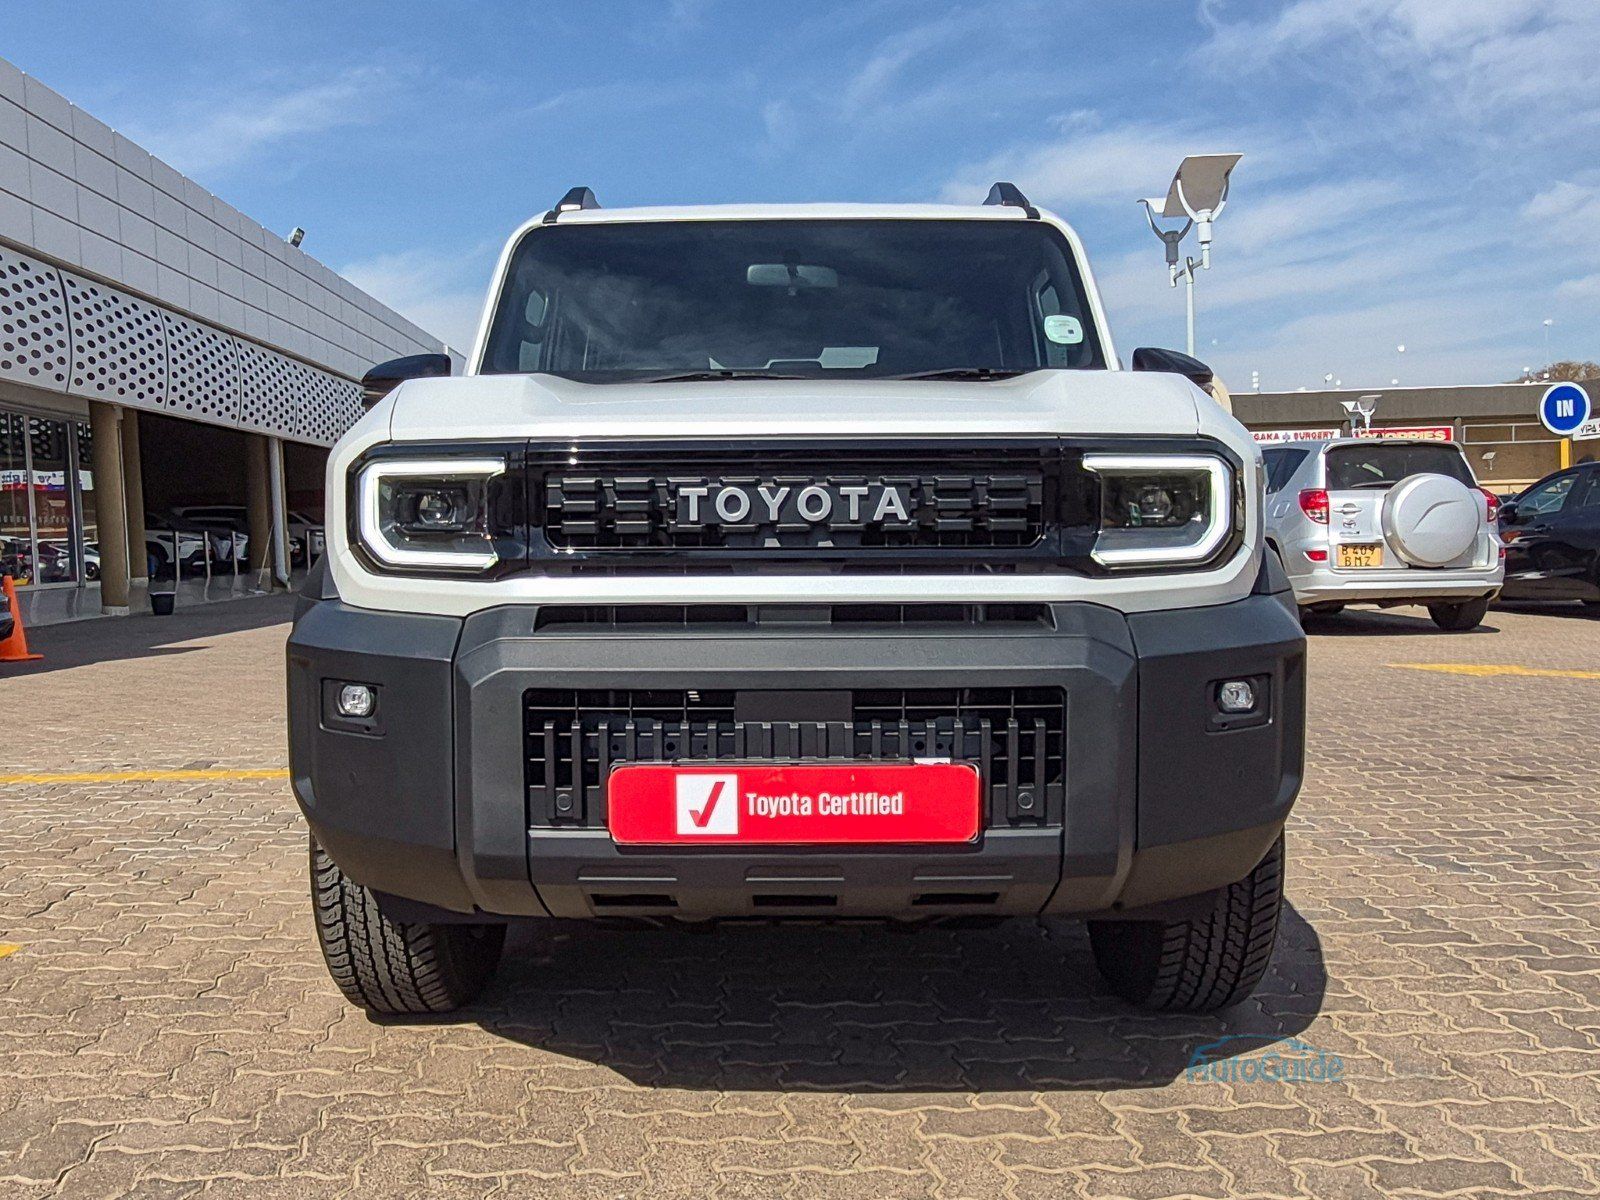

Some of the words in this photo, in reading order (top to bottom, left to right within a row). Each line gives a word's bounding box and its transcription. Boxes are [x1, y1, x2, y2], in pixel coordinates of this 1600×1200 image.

[1556, 399, 1574, 418] IN
[678, 486, 908, 523] TOYOTA
[1344, 556, 1372, 567] BMZ
[746, 792, 813, 819] Toyota
[818, 791, 904, 817] Certified
